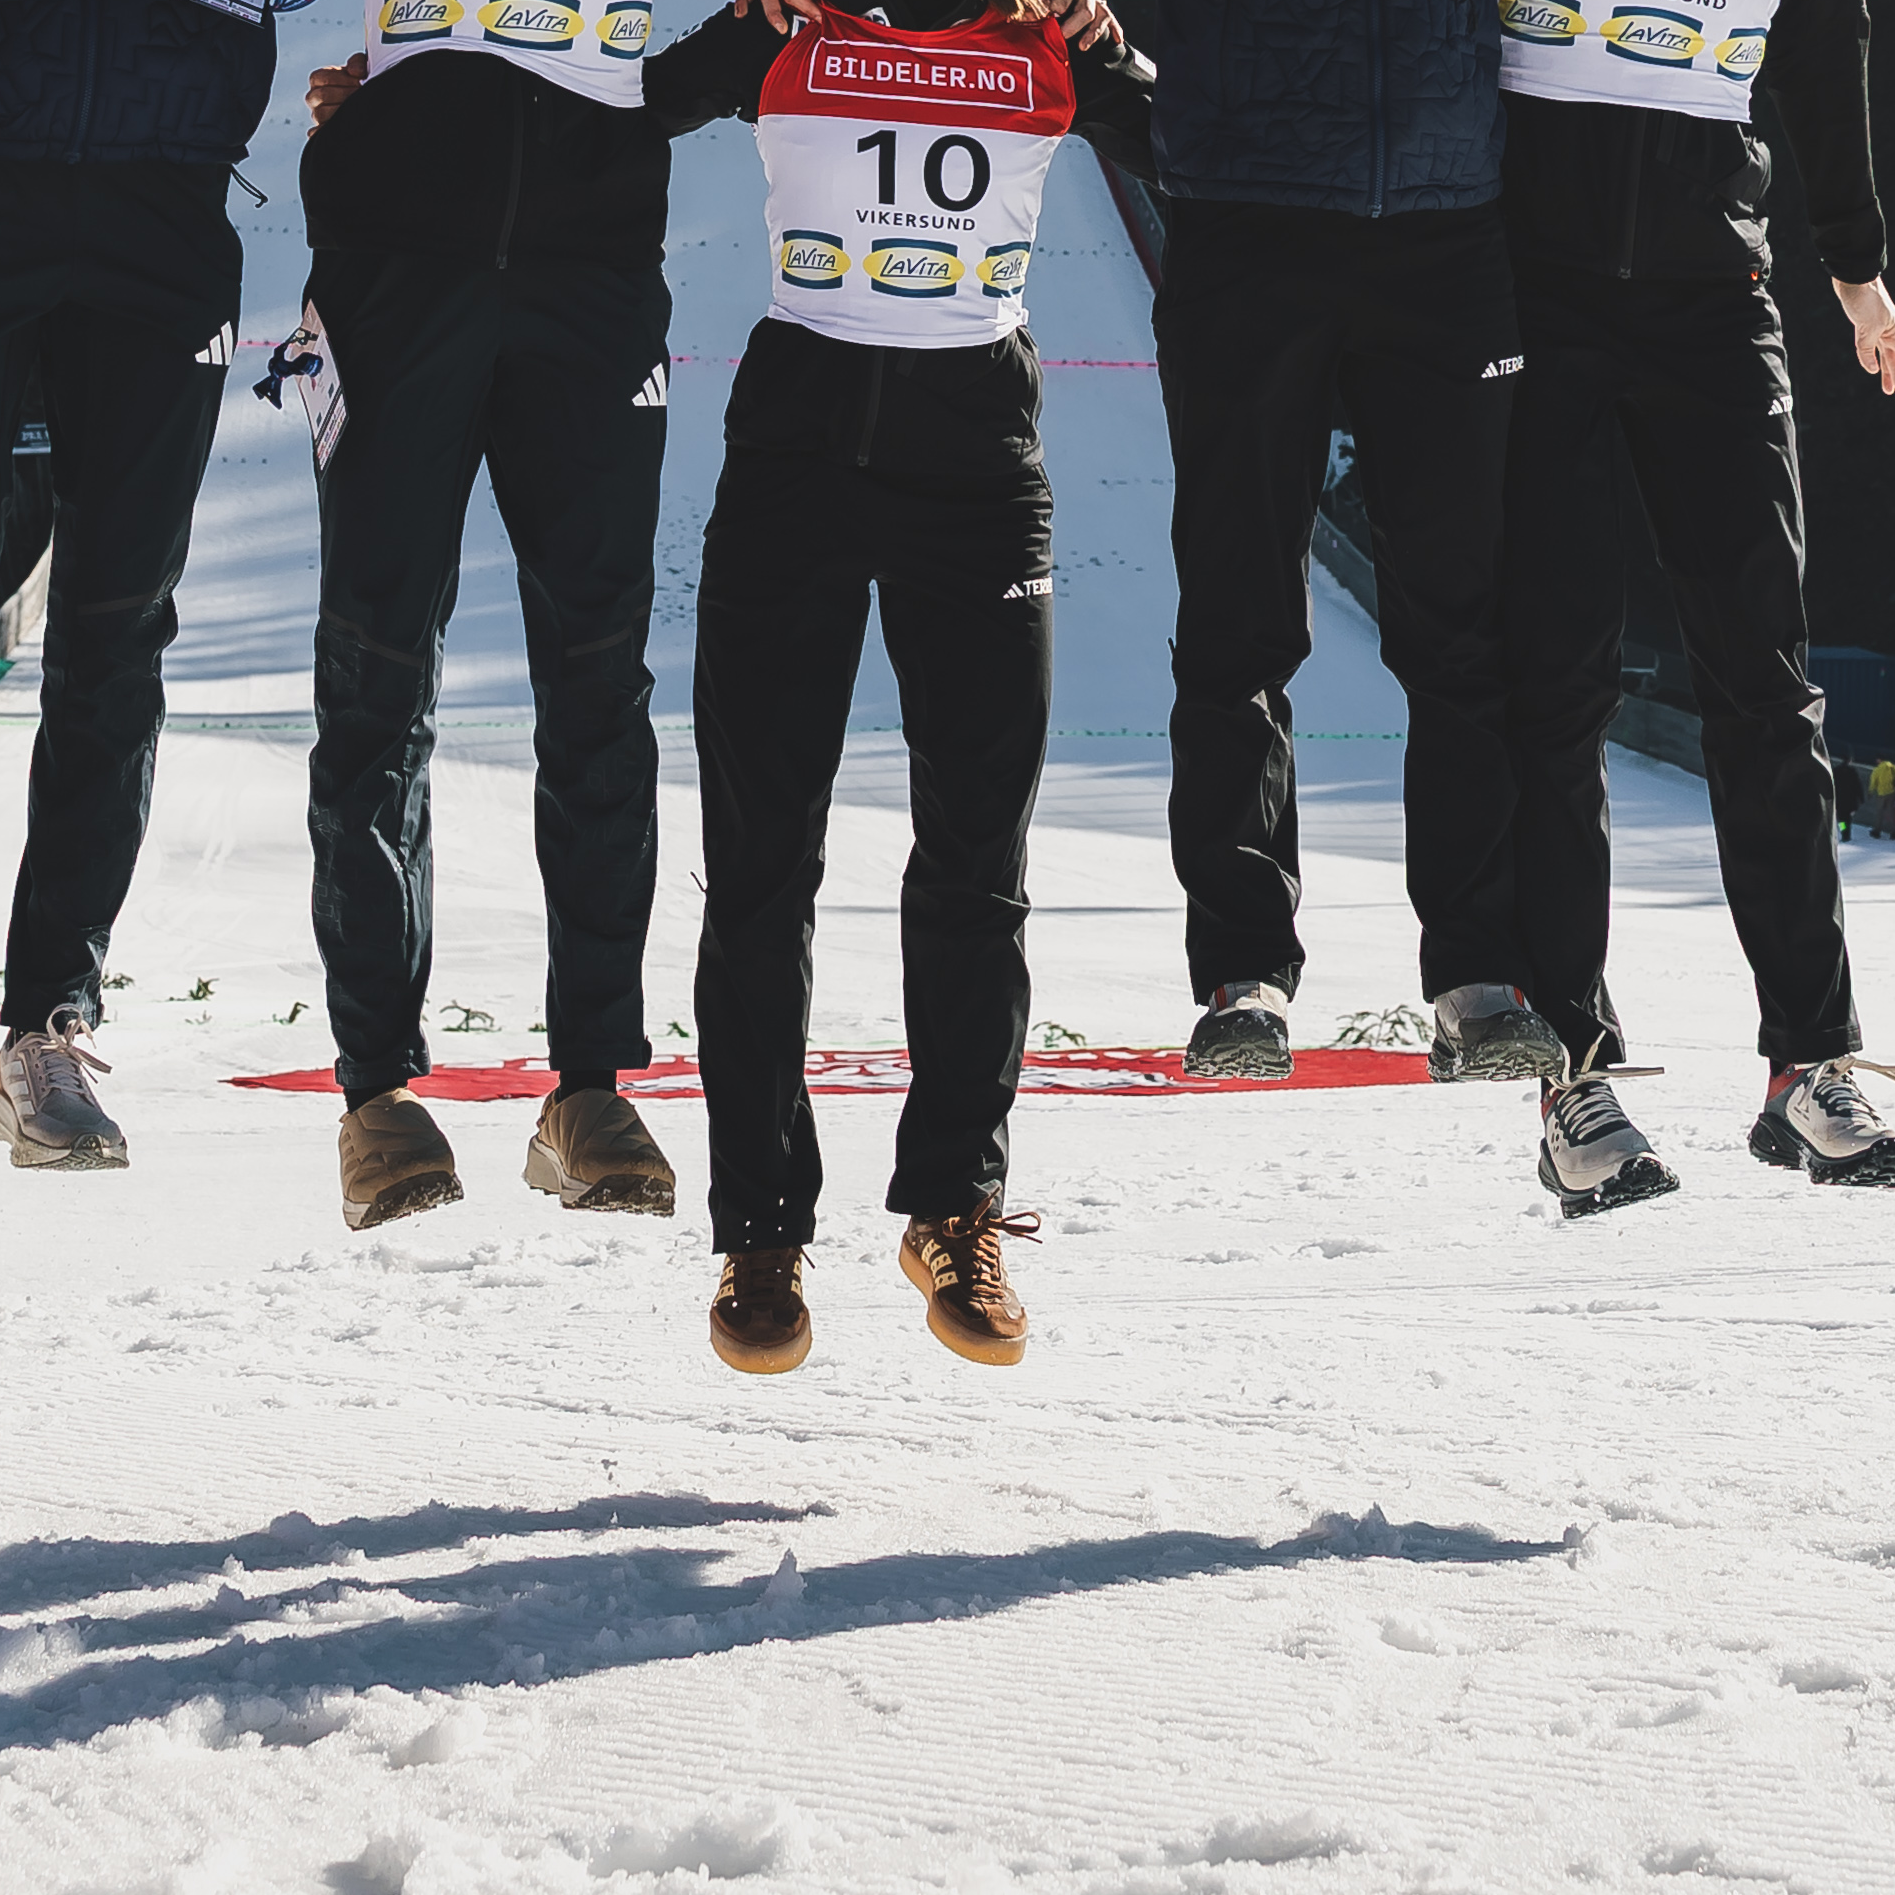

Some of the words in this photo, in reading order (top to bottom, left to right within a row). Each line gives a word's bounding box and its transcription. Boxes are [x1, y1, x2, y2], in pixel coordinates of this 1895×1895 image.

[824, 55, 1016, 94] BILDELER.NO
[856, 129, 991, 212] 10
[855, 209, 976, 231] VIKERSUND
